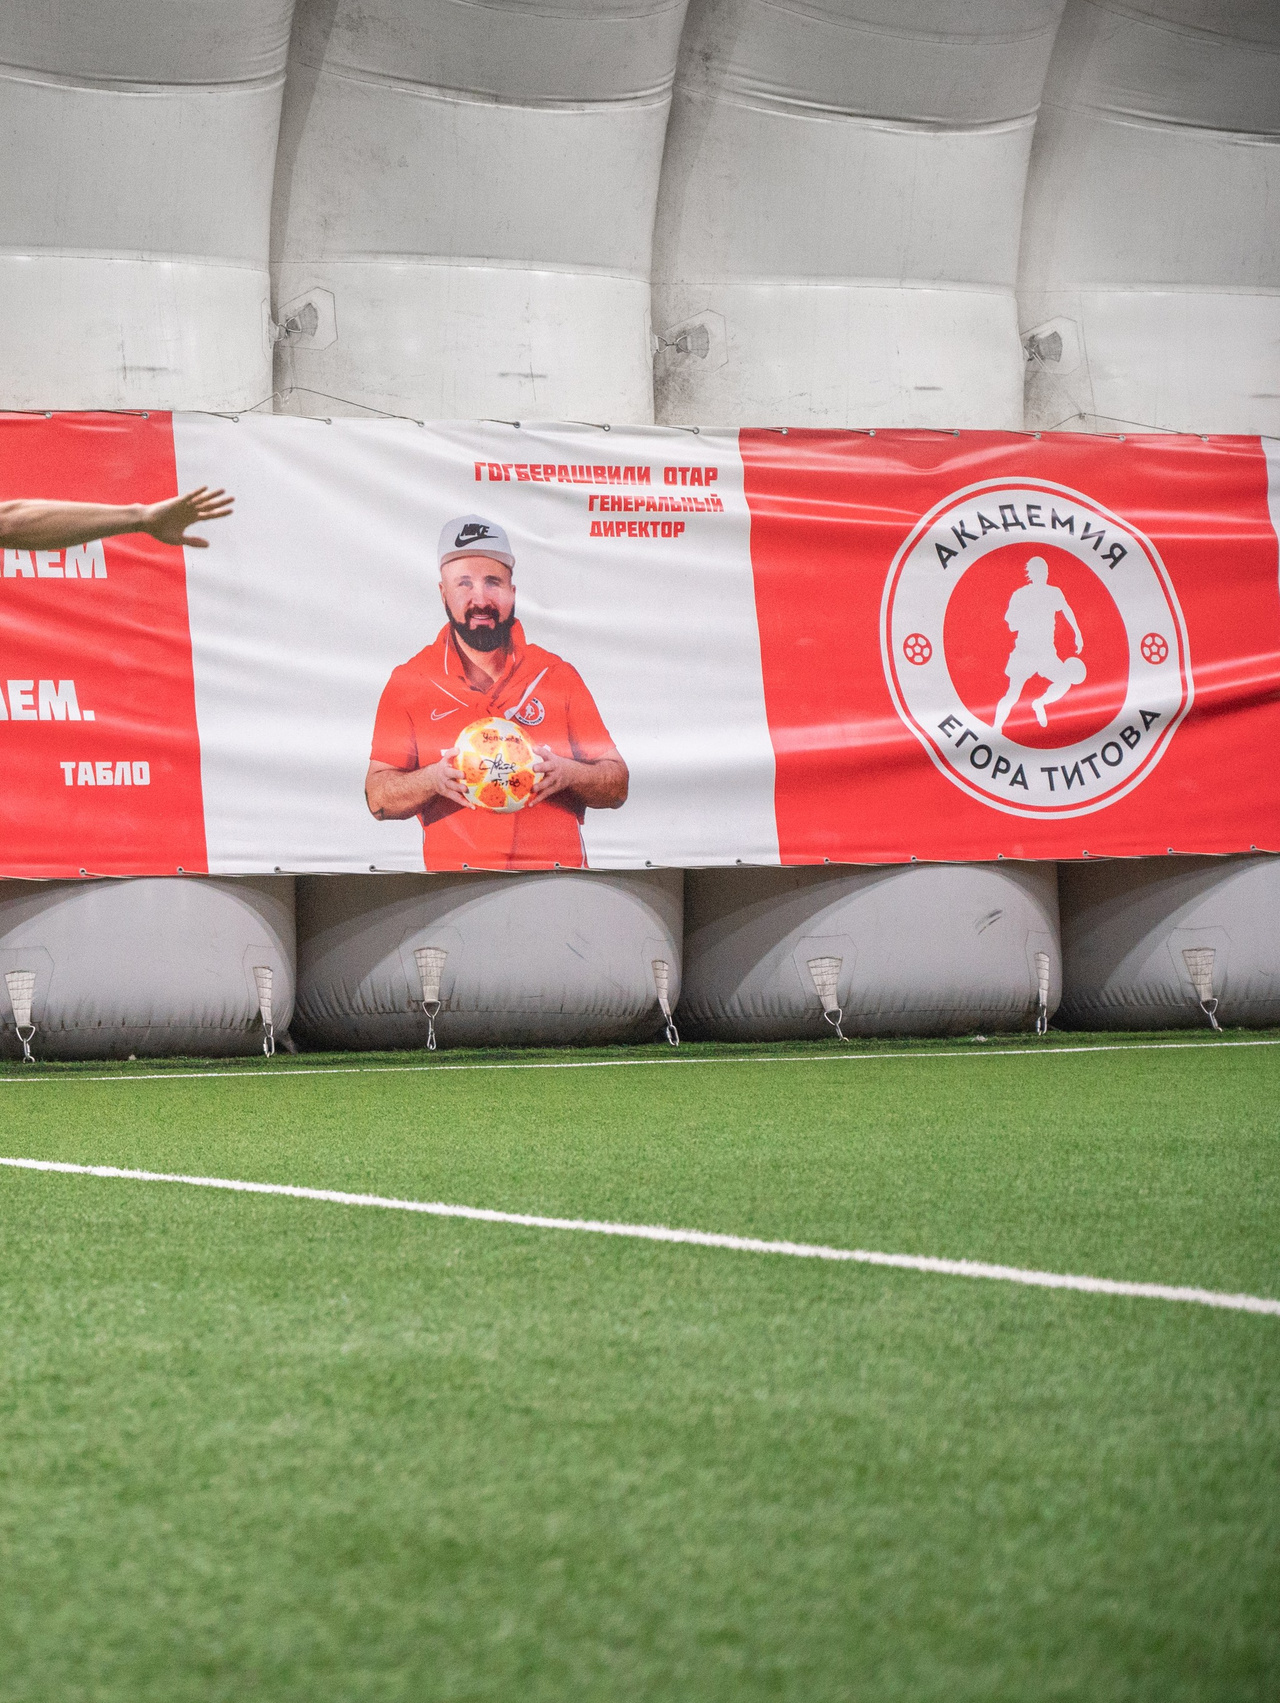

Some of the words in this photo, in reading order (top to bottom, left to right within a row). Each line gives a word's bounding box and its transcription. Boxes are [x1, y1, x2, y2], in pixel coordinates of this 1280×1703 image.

[664, 467, 718, 486] ОТАР
[589, 494, 724, 512] ГЕНЕРАЛЬНЫЙ
[590, 521, 685, 538] ДИРЕКТОР
[934, 504, 1128, 570] АКАДЕМИЯ
[938, 714, 1029, 790] ЕГОРА
[1041, 709, 1161, 791] ТИТОВА
[60, 761, 150, 786] ТАБЛО
